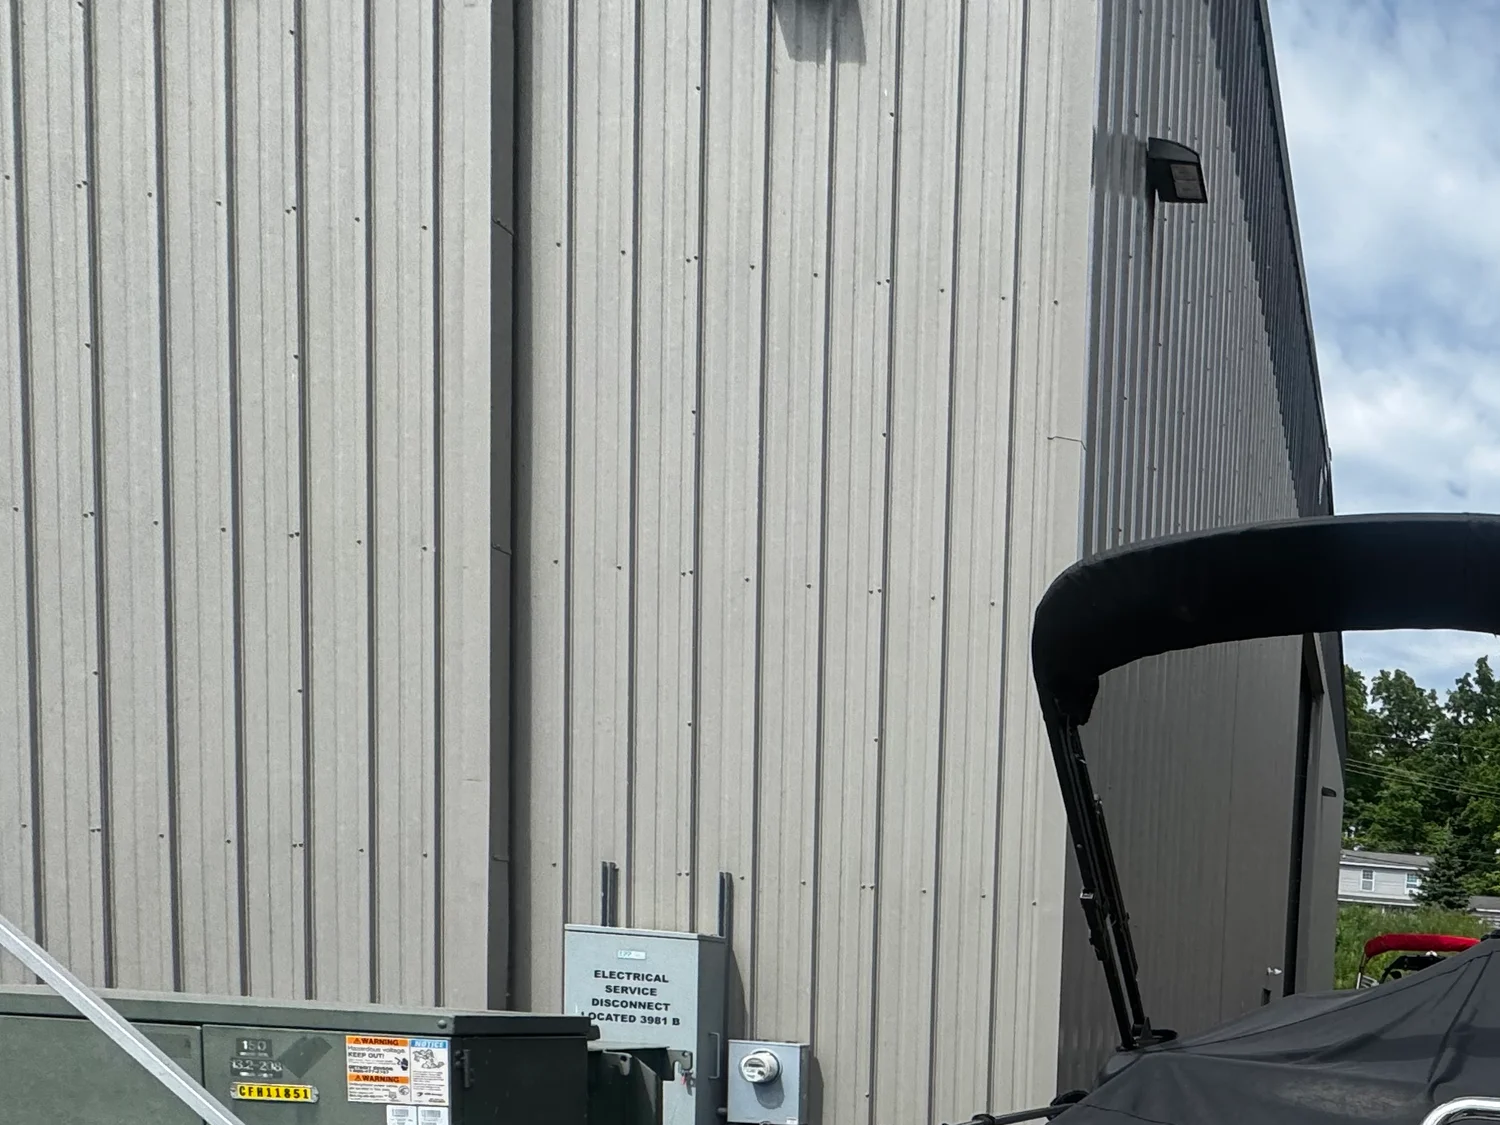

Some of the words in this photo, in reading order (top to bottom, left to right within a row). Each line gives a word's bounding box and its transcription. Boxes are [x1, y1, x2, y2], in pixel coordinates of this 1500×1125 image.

[594, 970, 669, 983] ELECTRICAL
[605, 985, 657, 996] SERVICE
[592, 998, 671, 1011] DISCONNECT
[582, 1011, 636, 1023] OCATED
[640, 1015, 668, 1026] 3981
[672, 1018, 680, 1026] B
[361, 1038, 399, 1046] WARNING
[414, 1040, 444, 1048] NOTICE
[362, 1075, 400, 1083] WARNING
[239, 1086, 309, 1099] CFH11851
